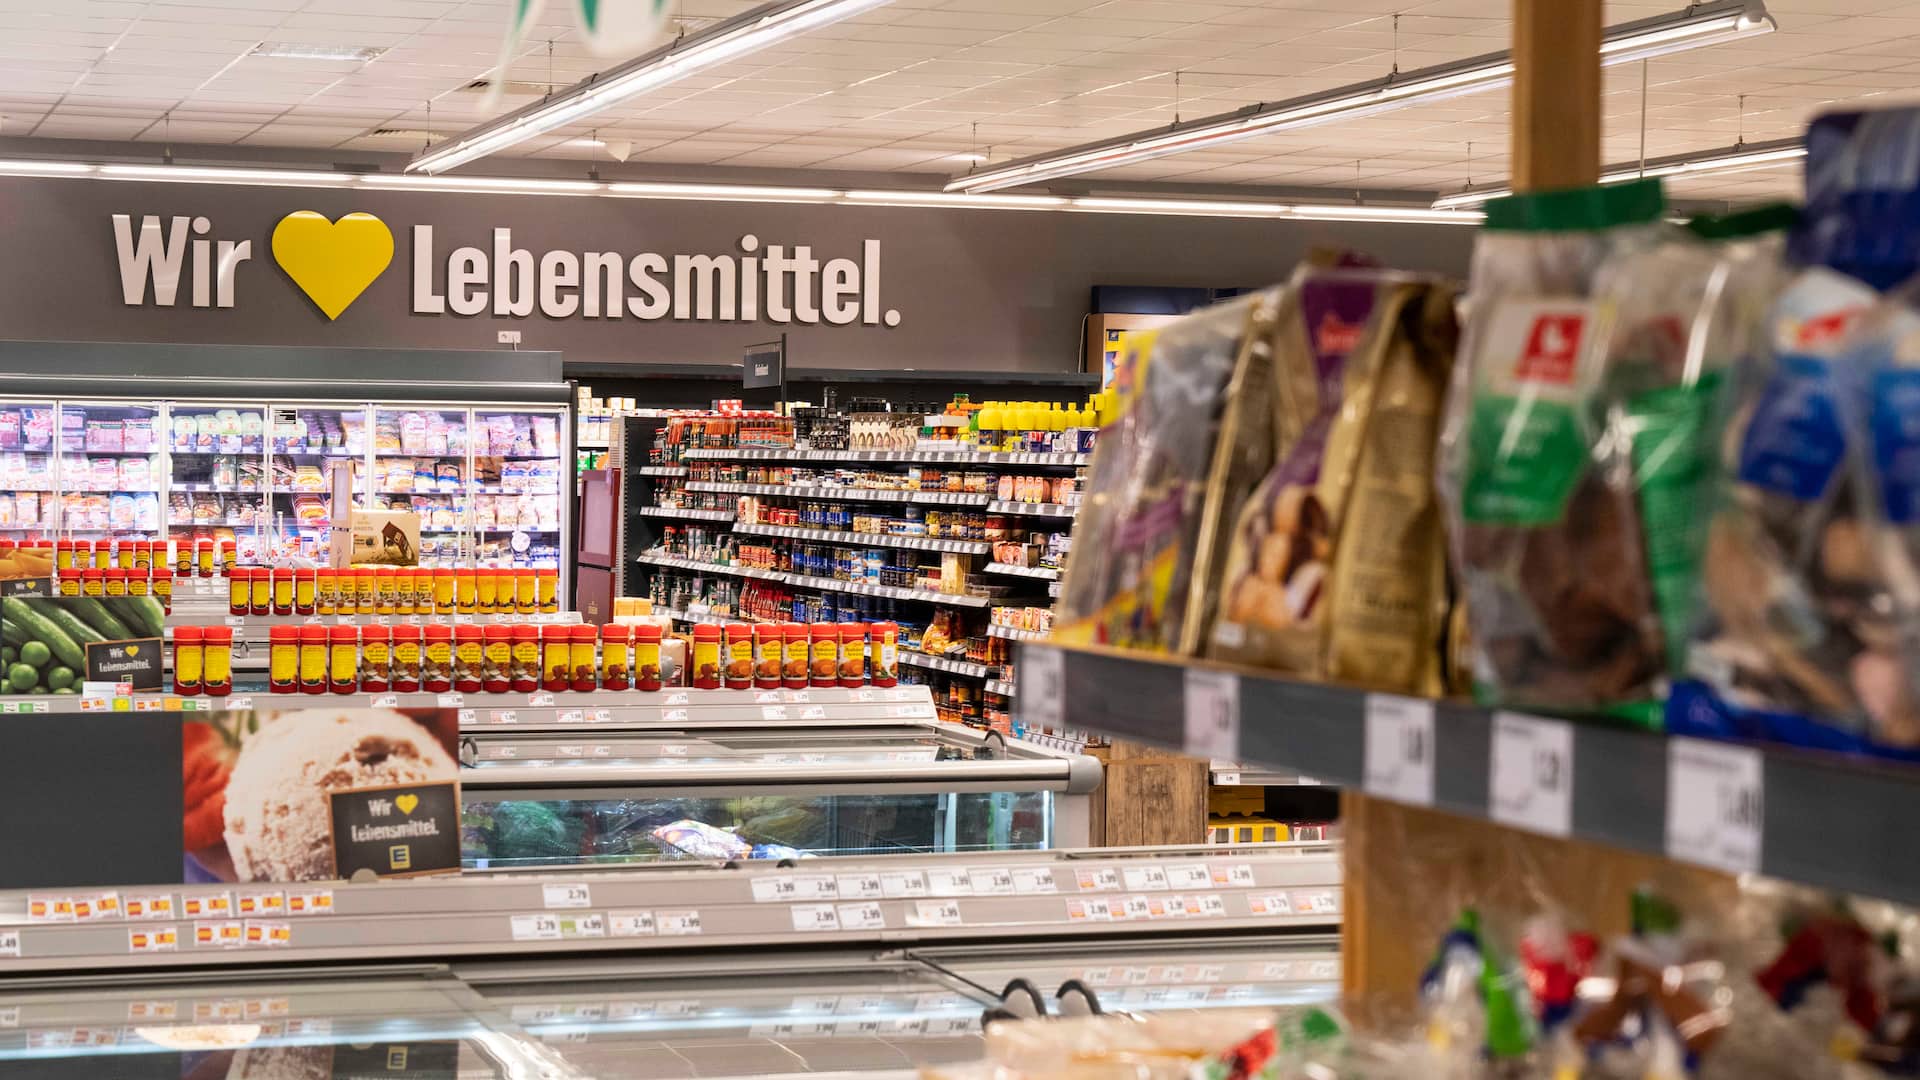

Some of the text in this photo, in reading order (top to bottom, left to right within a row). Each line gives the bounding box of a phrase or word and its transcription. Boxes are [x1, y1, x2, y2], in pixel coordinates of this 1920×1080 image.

[111, 213, 901, 328] Wir Lebensmittel.
[109, 647, 125, 659] Wir
[368, 798, 393, 817] Wir
[350, 817, 441, 843] Lebensmittel.
[776, 882, 795, 893] 2.99
[817, 881, 836, 892] 2.99
[861, 880, 879, 891] 2.99
[568, 889, 588, 900] 2.79
[816, 911, 835, 921] 2.99
[862, 909, 881, 920] 2.99
[939, 907, 958, 918] 2.99
[633, 918, 653, 929] 2.99
[680, 918, 700, 929] 2.99
